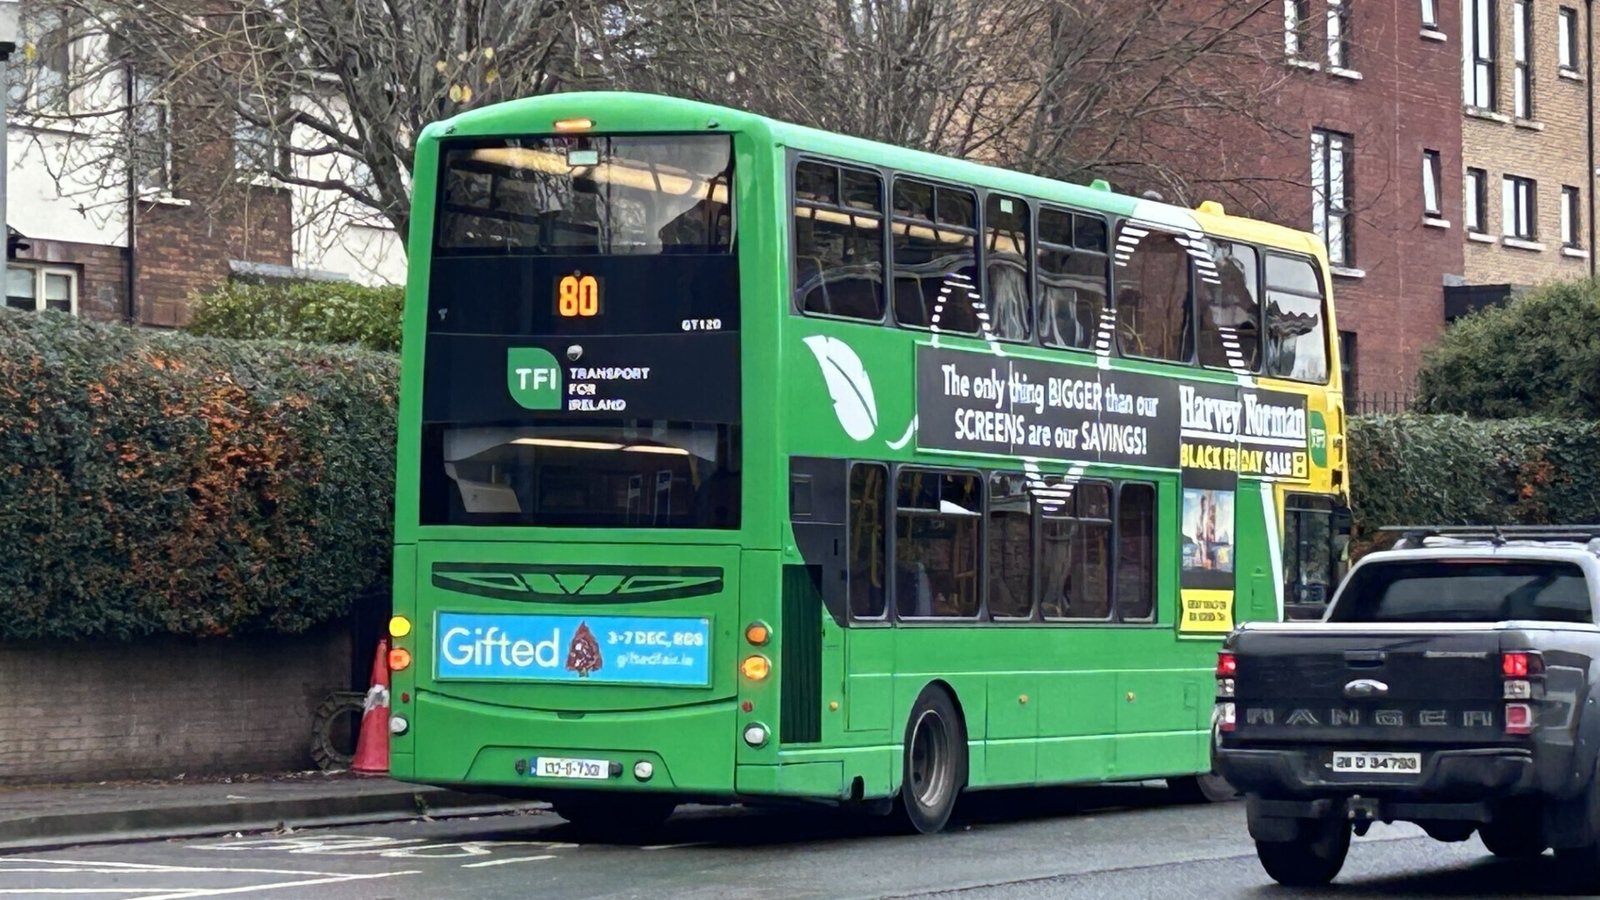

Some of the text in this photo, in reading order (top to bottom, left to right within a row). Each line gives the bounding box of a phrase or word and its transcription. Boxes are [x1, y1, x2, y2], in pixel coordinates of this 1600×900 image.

[559, 275, 598, 317] 80
[515, 368, 557, 390] TFI
[570, 367, 650, 380] TRANSPORT
[568, 383, 597, 396] FOR
[942, 364, 1159, 417] The only thing BIGGER than our
[568, 399, 627, 411] IRELAND
[1179, 385, 1306, 441] Harvey Norman
[954, 408, 1147, 455] SCREENS are our SAVINGS!
[1181, 443, 1221, 470] BLACK
[1264, 451, 1291, 475] SALE
[442, 627, 560, 668] Gifted
[607, 631, 633, 645] 3-7
[634, 631, 672, 647] DEC,
[1246, 708, 1493, 727] RANGER
